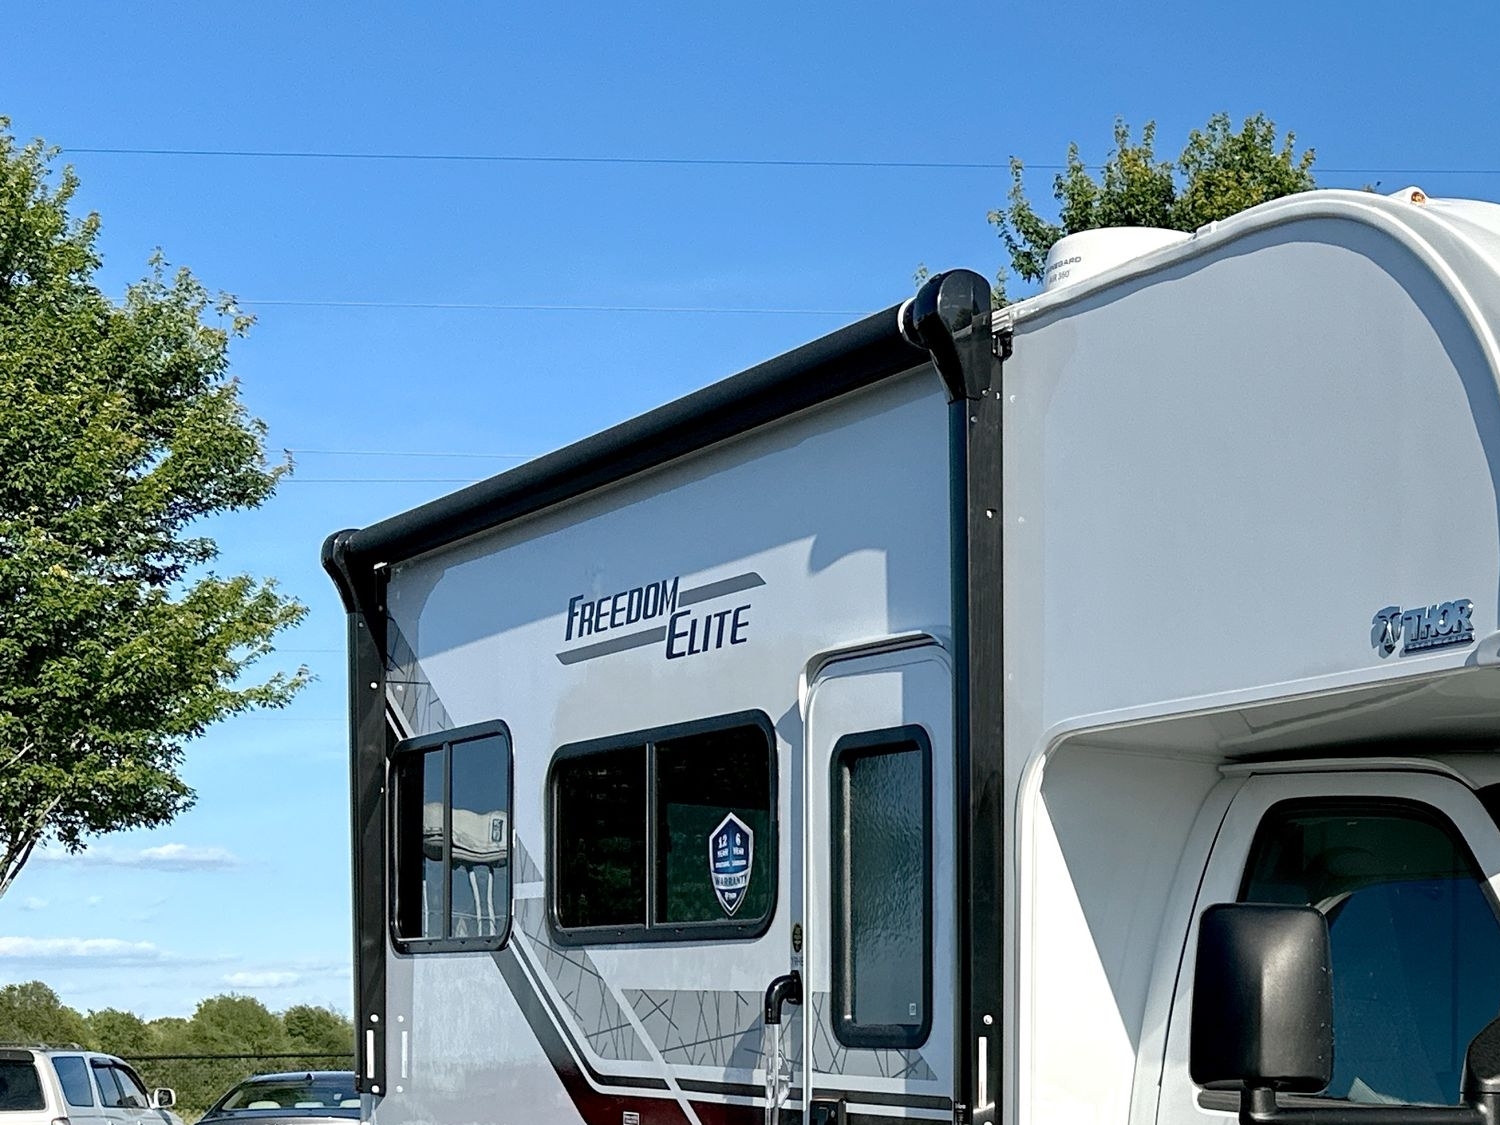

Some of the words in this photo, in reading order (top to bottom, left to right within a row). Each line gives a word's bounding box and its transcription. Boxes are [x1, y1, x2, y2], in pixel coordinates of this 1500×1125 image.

[564, 576, 680, 642] FREEDOM
[1402, 599, 1475, 642] THOR
[665, 603, 751, 660] ELITE
[718, 834, 728, 849] 12
[735, 832, 741, 846] 6
